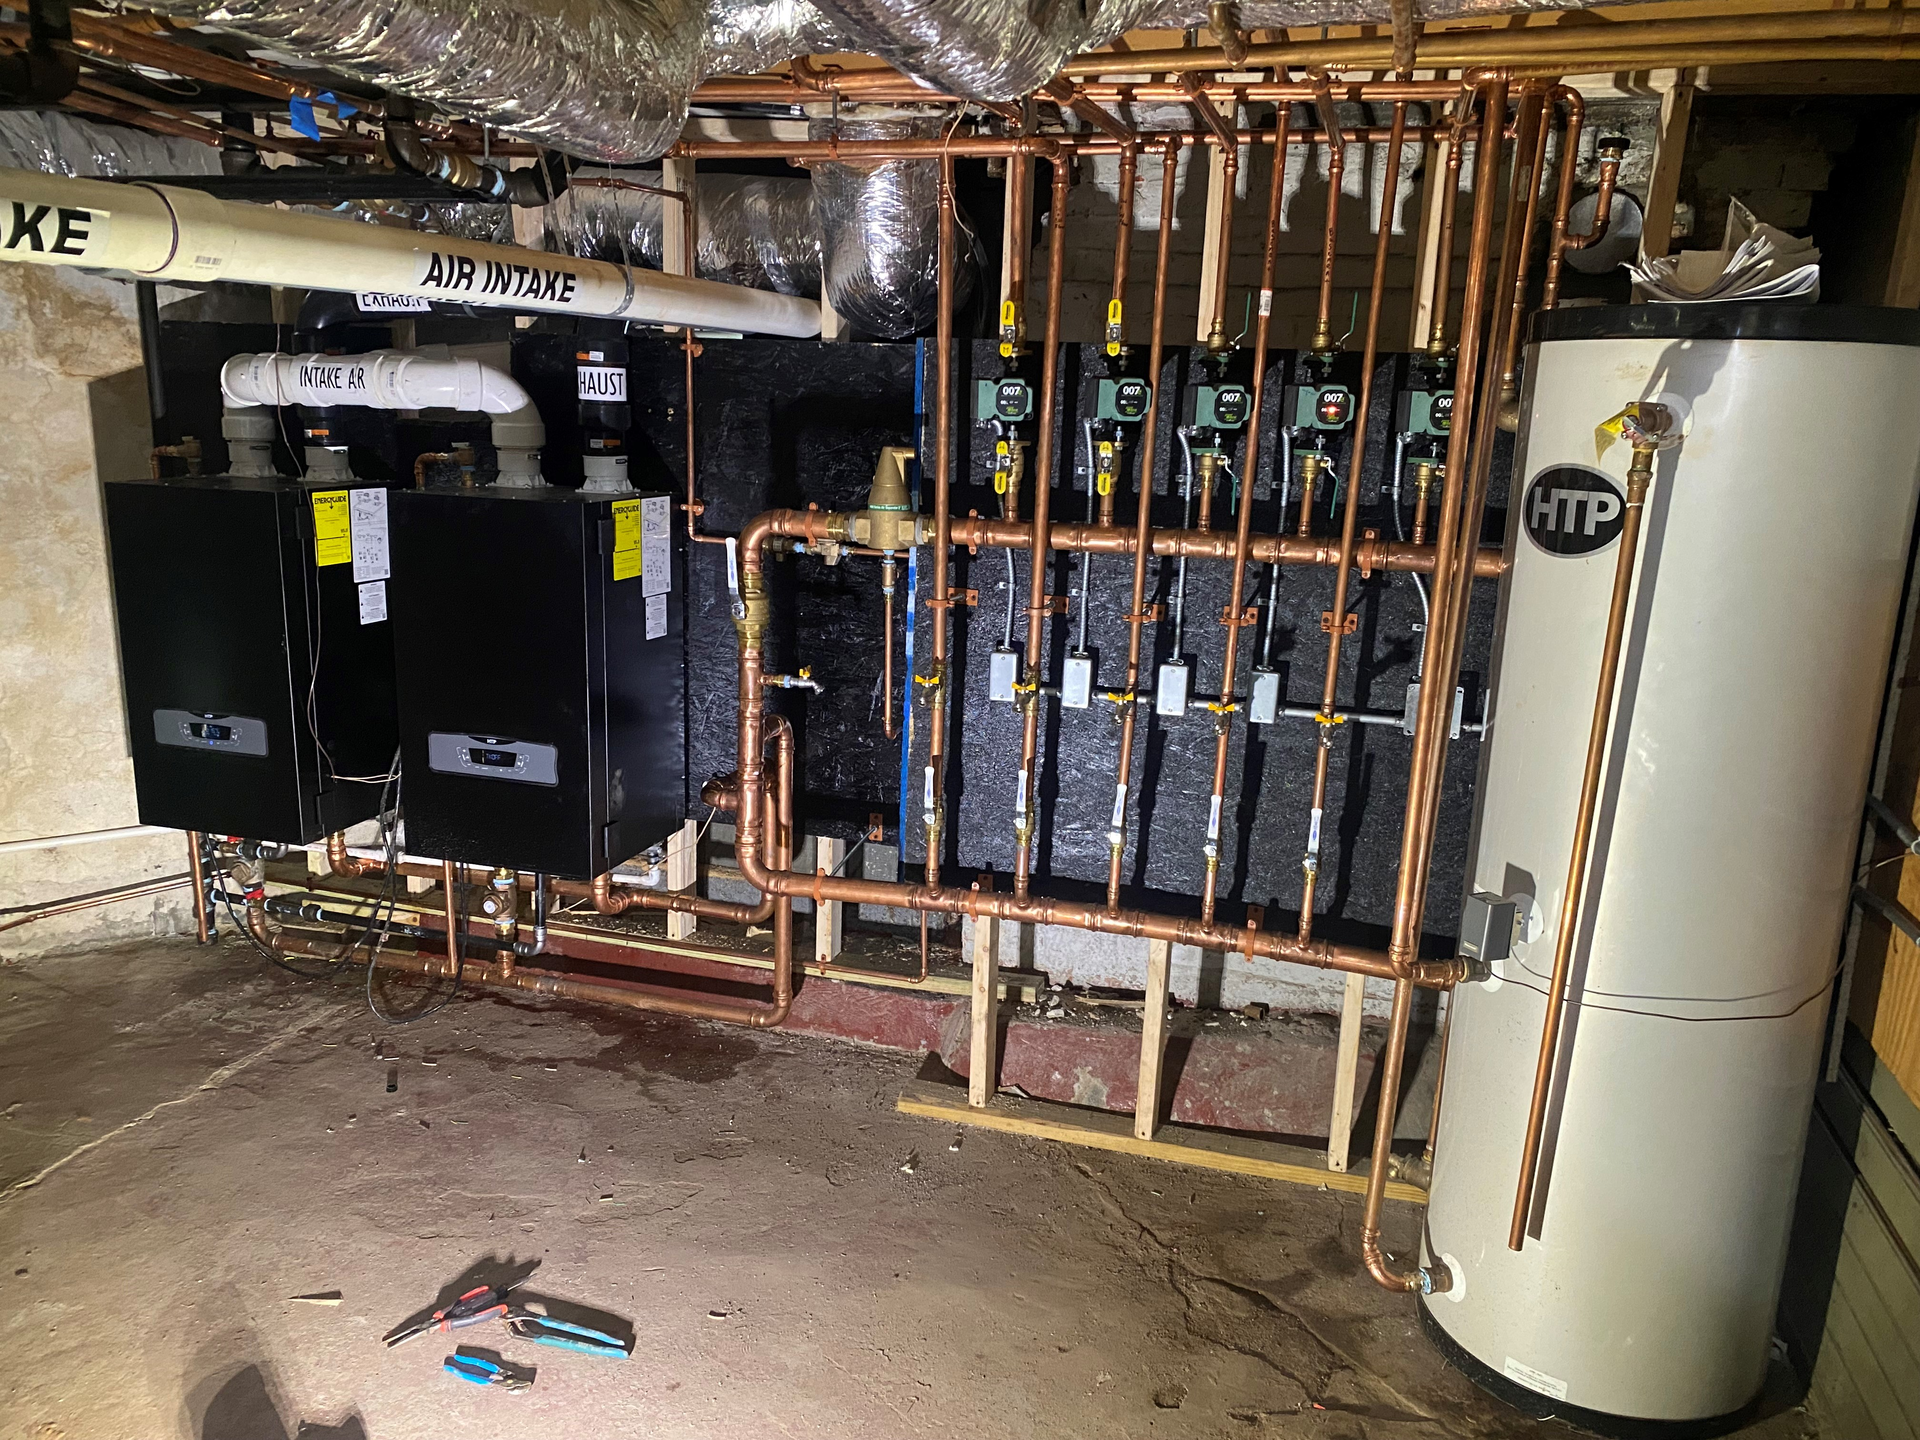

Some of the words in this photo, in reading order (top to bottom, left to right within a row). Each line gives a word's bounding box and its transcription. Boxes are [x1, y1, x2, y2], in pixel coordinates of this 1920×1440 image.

[0, 200, 92, 256] KE
[420, 251, 476, 291] AIR
[481, 259, 577, 303] INTAKE
[299, 365, 343, 390] INTAKE
[348, 367, 366, 390] AR
[1438, 398, 1454, 408] 00
[1530, 486, 1622, 537] HTP
